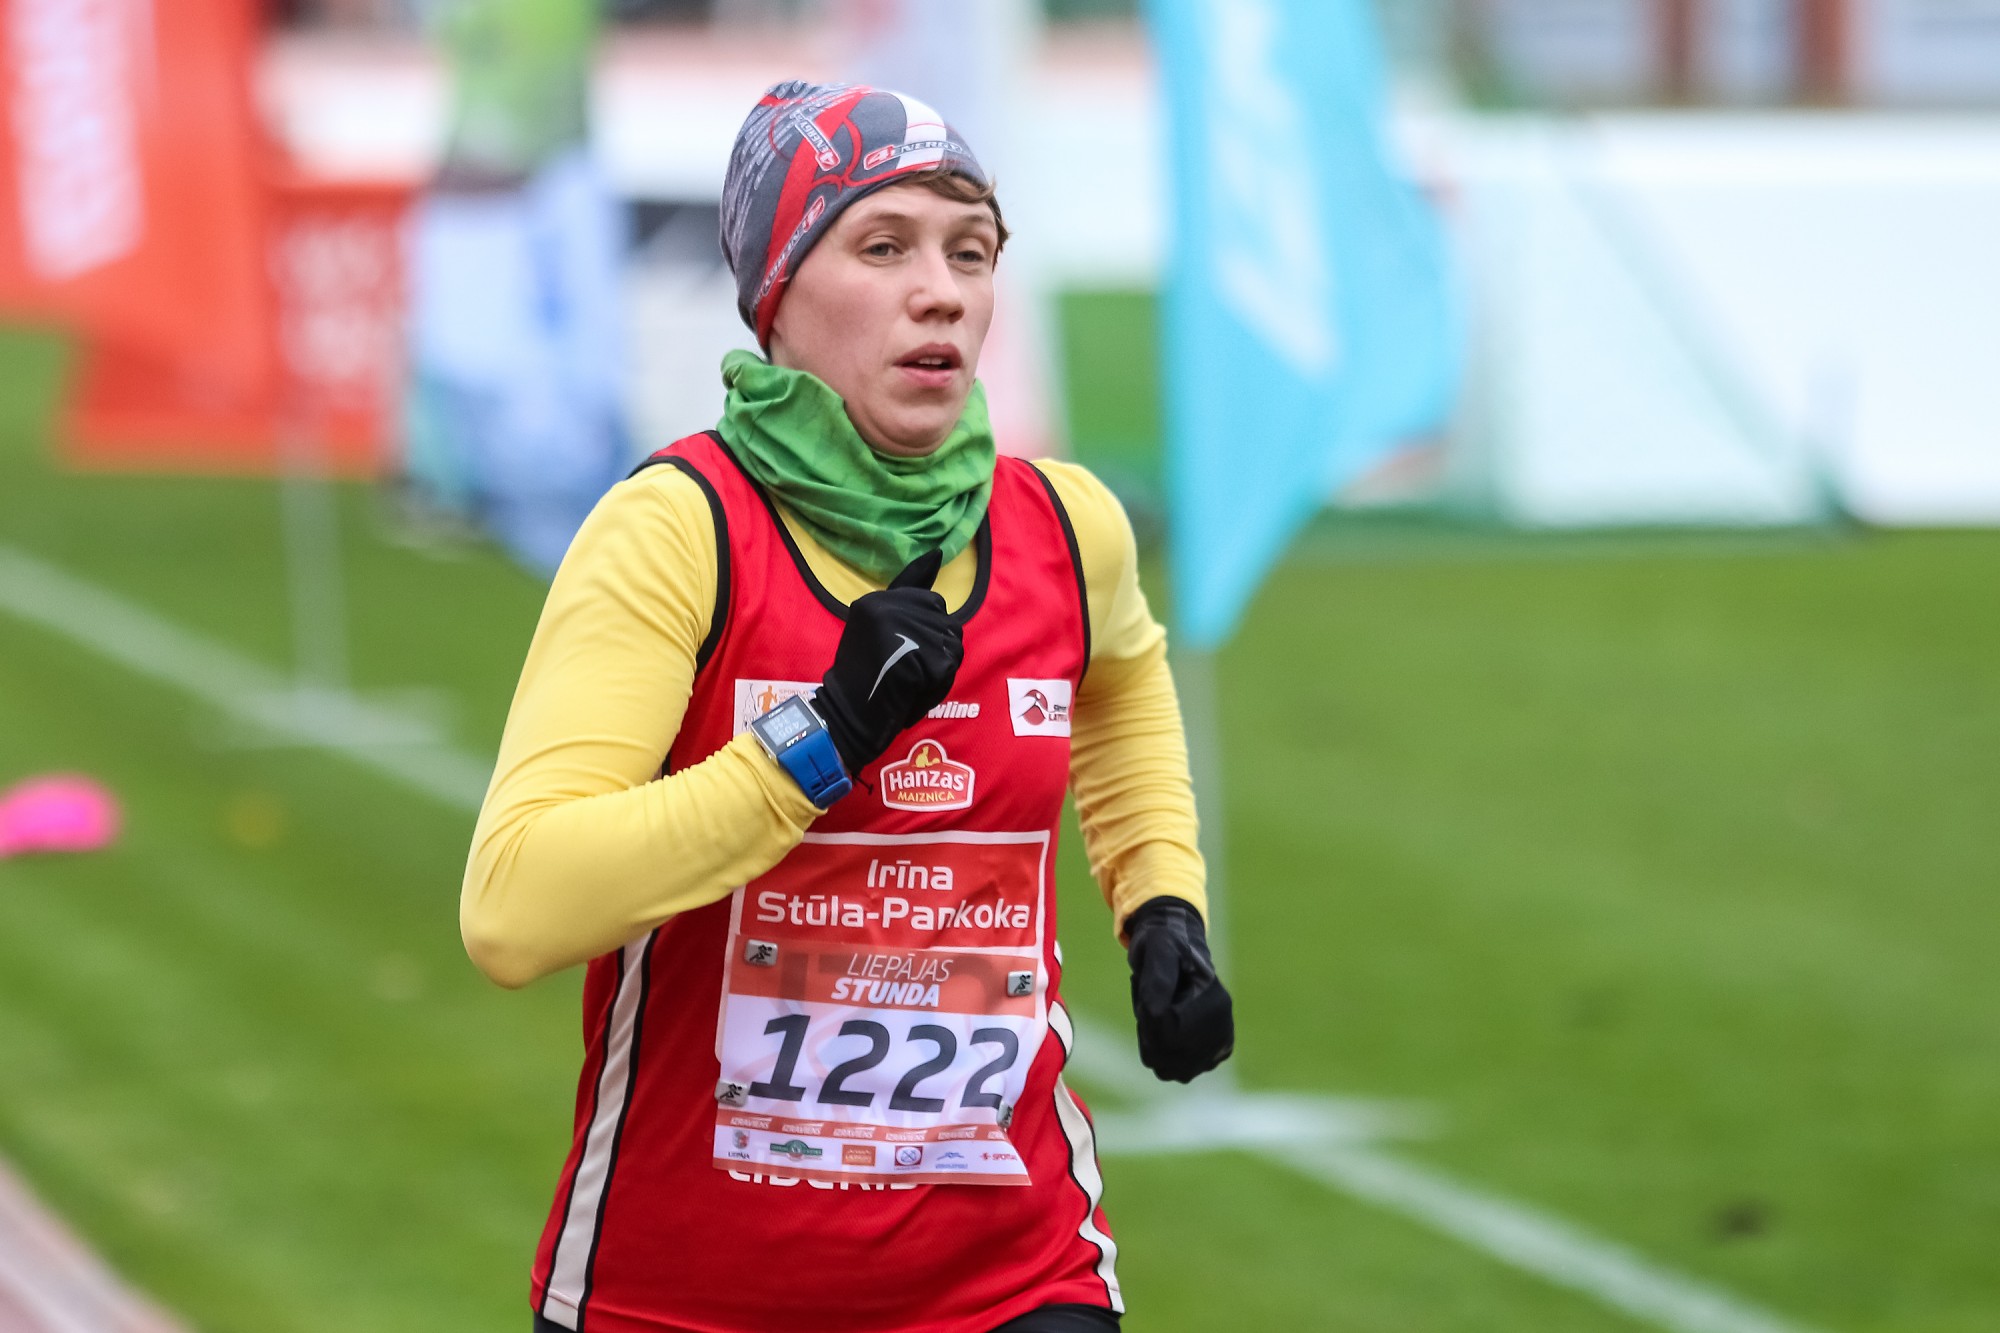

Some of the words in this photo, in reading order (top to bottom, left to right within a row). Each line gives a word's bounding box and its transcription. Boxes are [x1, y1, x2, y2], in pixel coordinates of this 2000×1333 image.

[889, 769, 965, 792] Hanzas
[866, 858, 953, 891] Irīna
[757, 891, 1030, 930] Stūla-Pankoka
[847, 953, 953, 982] LIEPĀJAS
[831, 977, 940, 1007] STUNDA
[748, 1014, 1019, 1112] 1222
